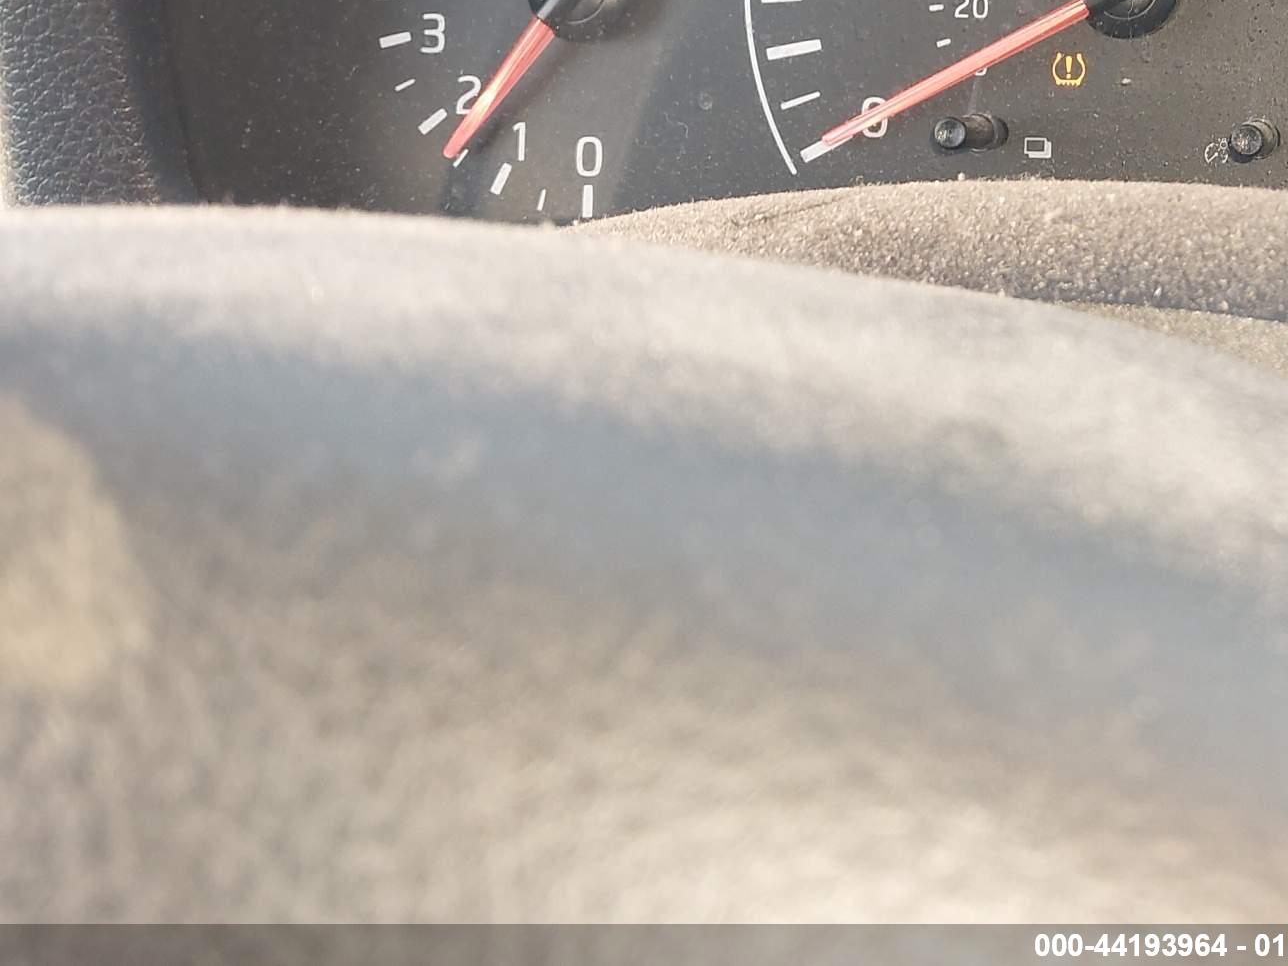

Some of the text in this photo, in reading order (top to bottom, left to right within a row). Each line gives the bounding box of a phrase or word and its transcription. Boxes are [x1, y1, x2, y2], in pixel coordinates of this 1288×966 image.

[421, 13, 446, 54] 3
[456, 75, 483, 115] 2
[513, 122, 527, 161] 1
[576, 136, 603, 177] 0
